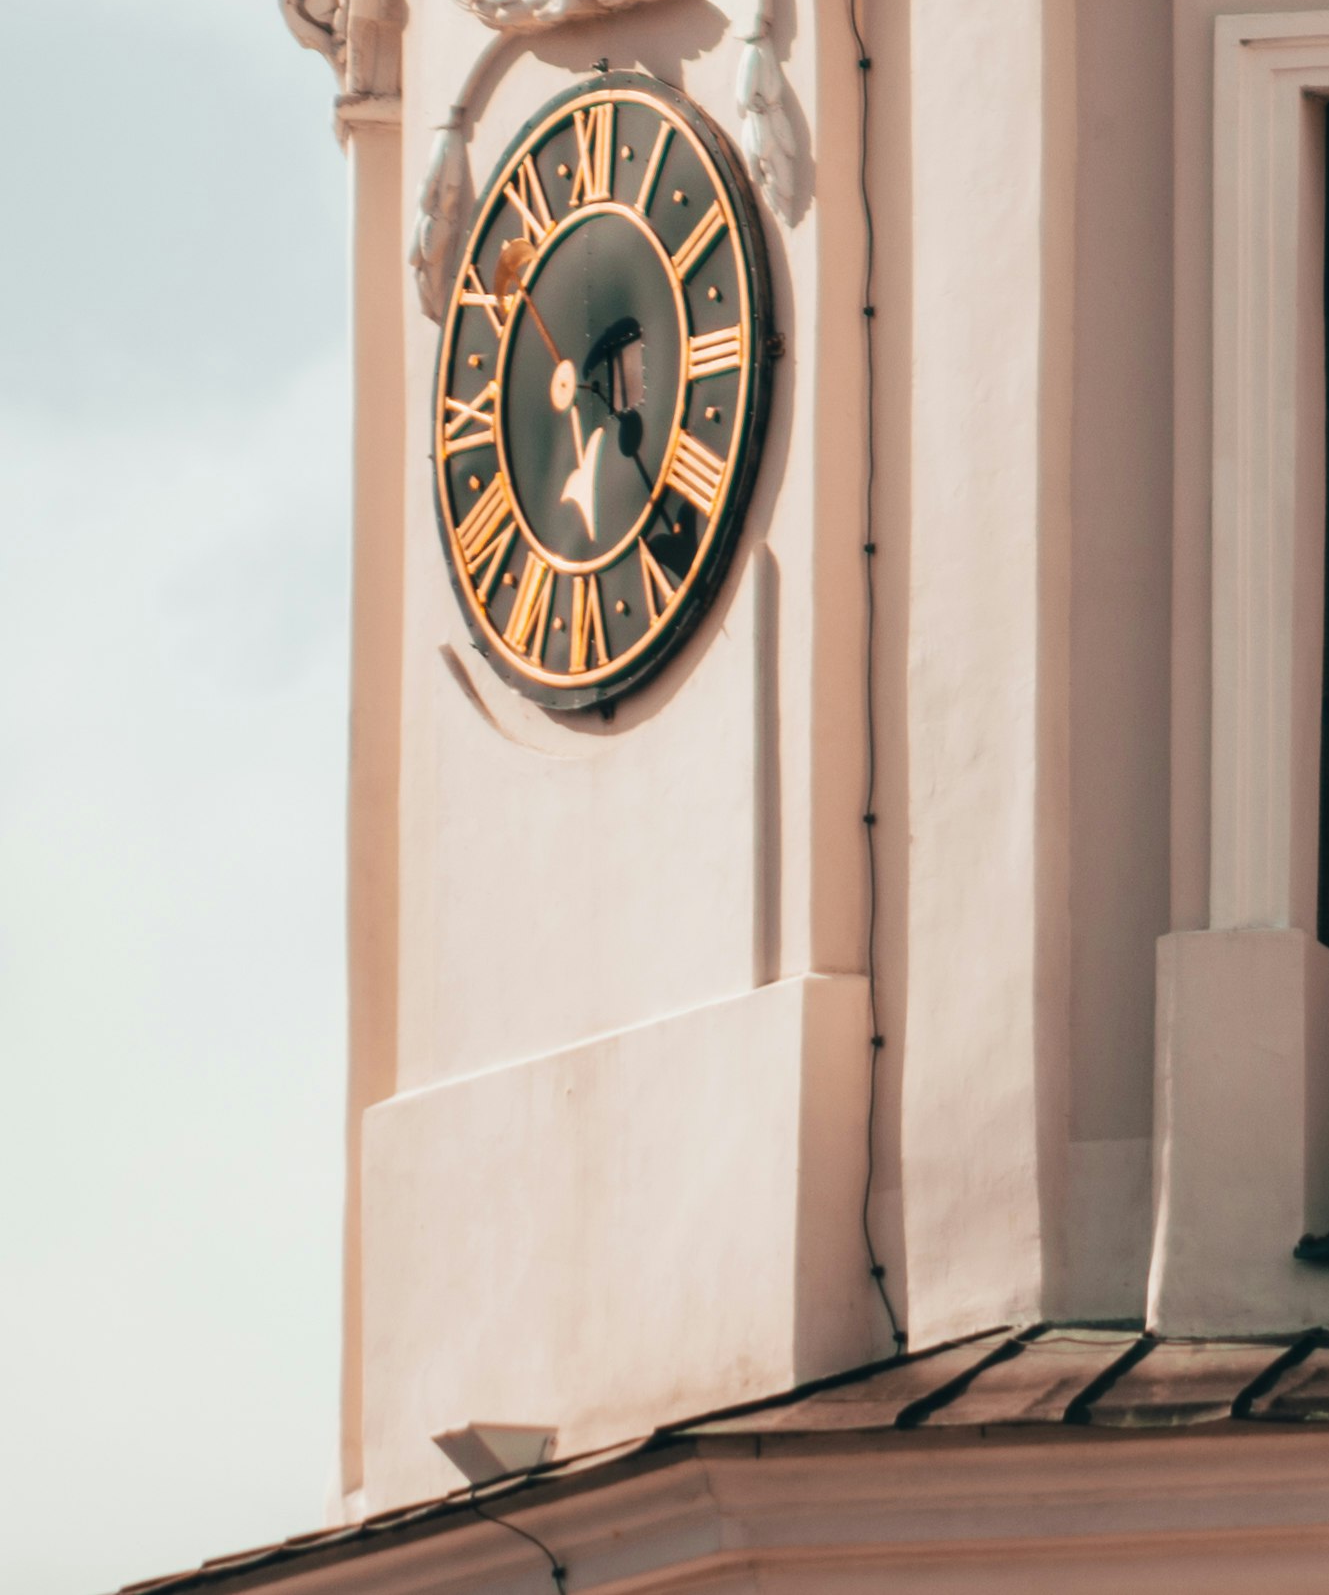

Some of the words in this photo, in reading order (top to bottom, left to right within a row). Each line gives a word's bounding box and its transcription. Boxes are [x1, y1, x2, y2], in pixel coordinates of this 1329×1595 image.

[503, 153, 556, 241] XI
[569, 102, 615, 206] XII
[635, 120, 675, 216] I
[672, 200, 728, 281] II
[458, 264, 514, 336] X
[687, 323, 741, 380] III
[444, 380, 498, 459] IX
[569, 574, 610, 674] VI
[638, 535, 676, 626] V
